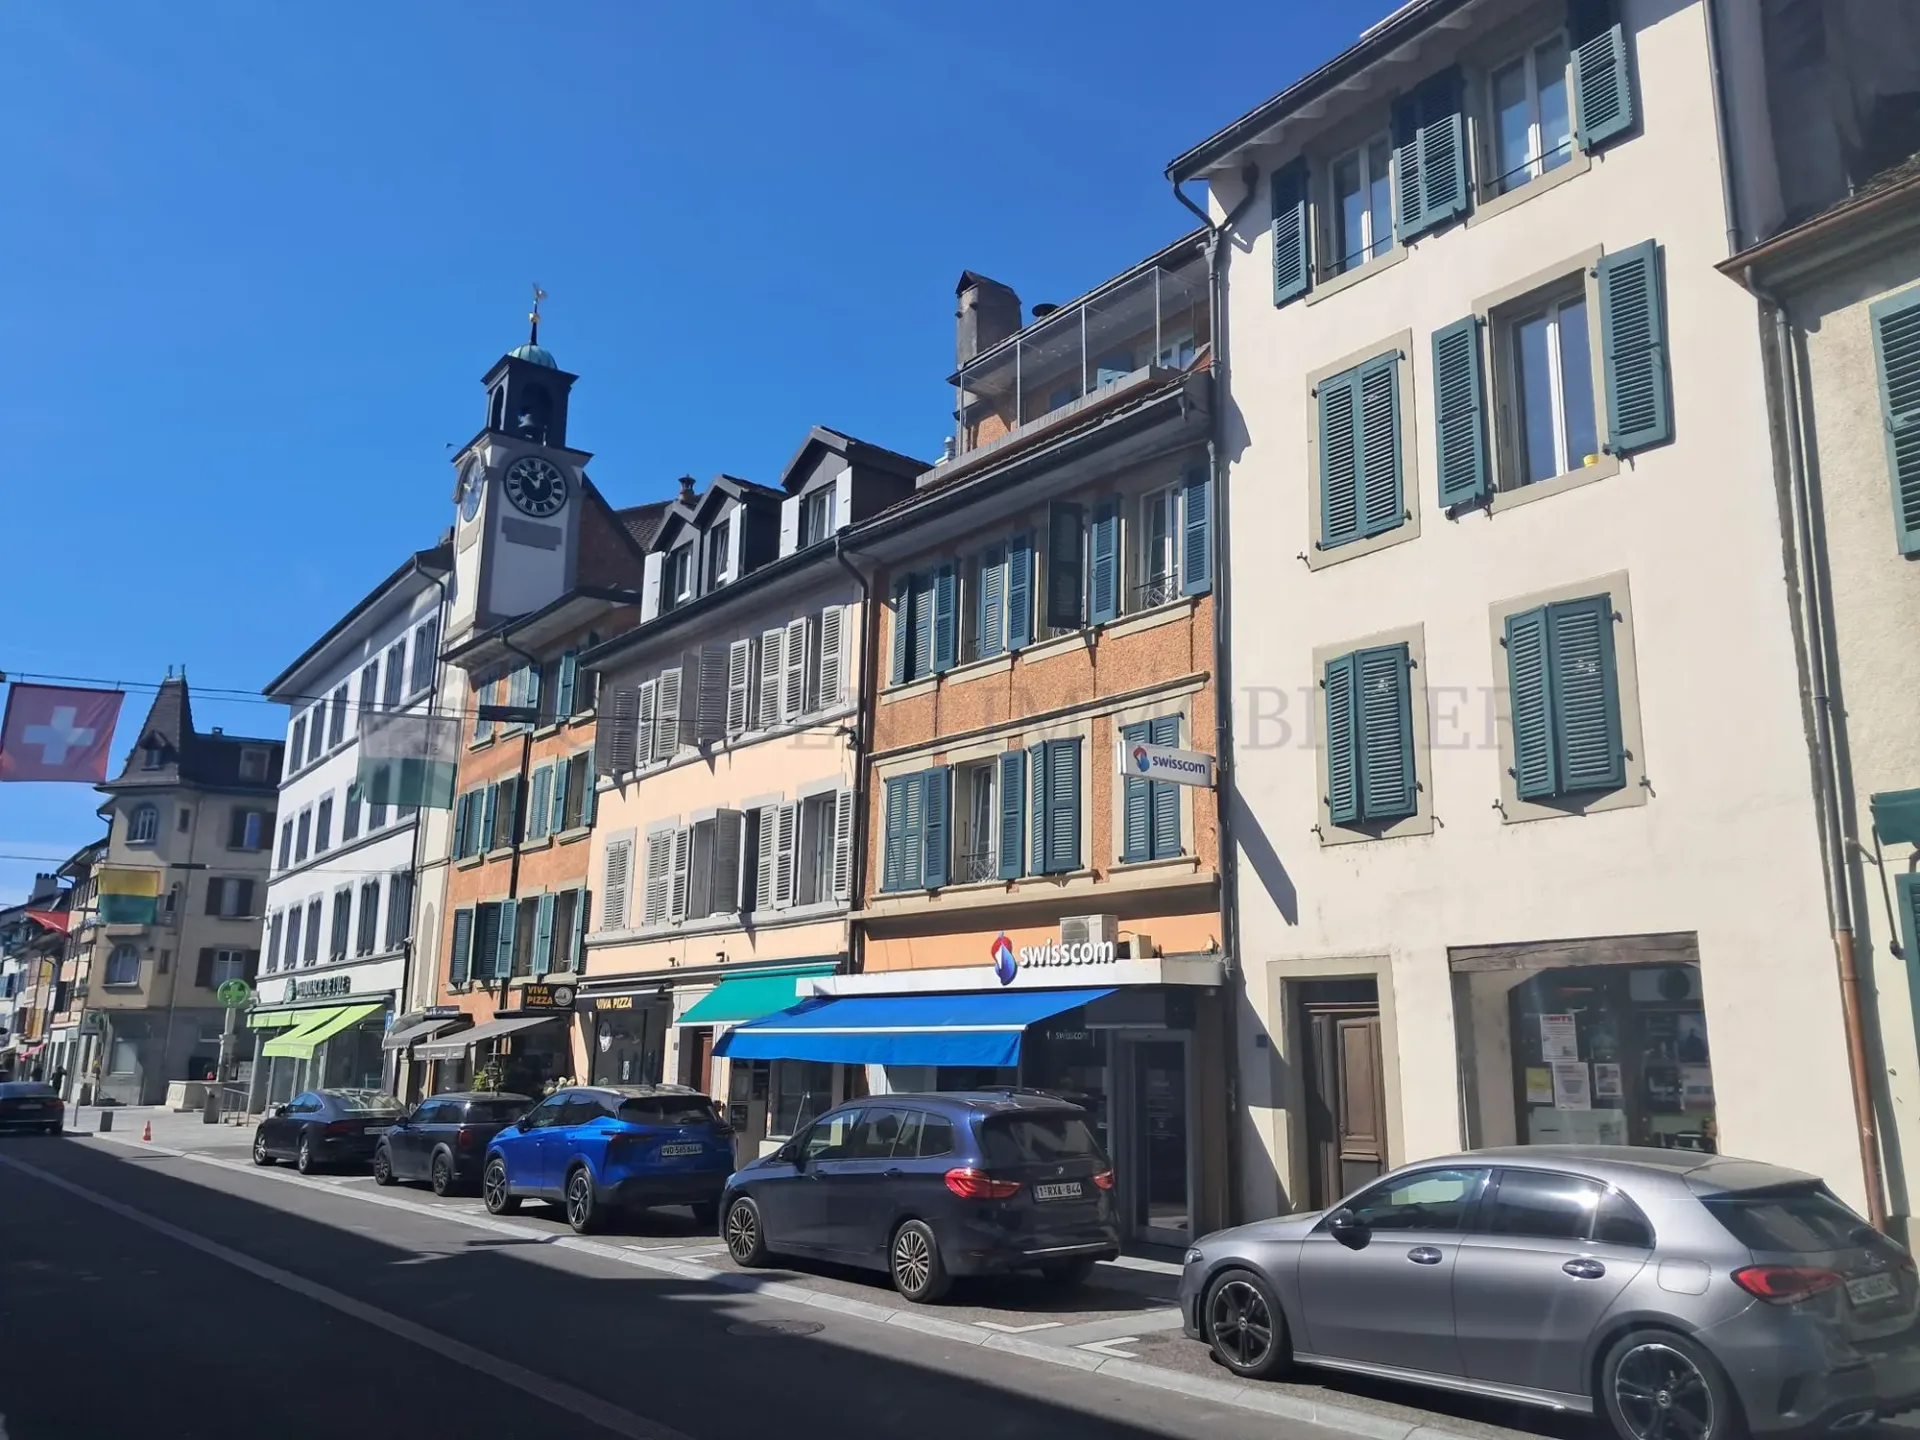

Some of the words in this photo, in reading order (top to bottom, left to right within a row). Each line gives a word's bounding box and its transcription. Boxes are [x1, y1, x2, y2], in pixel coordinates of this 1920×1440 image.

[1152, 754, 1206, 774] swisscom
[1020, 937, 1115, 968] swisscom
[527, 986, 548, 995] VIVA
[527, 996, 553, 1005] PIZZA
[596, 998, 611, 1009] VIVA
[613, 997, 632, 1009] PIZZA
